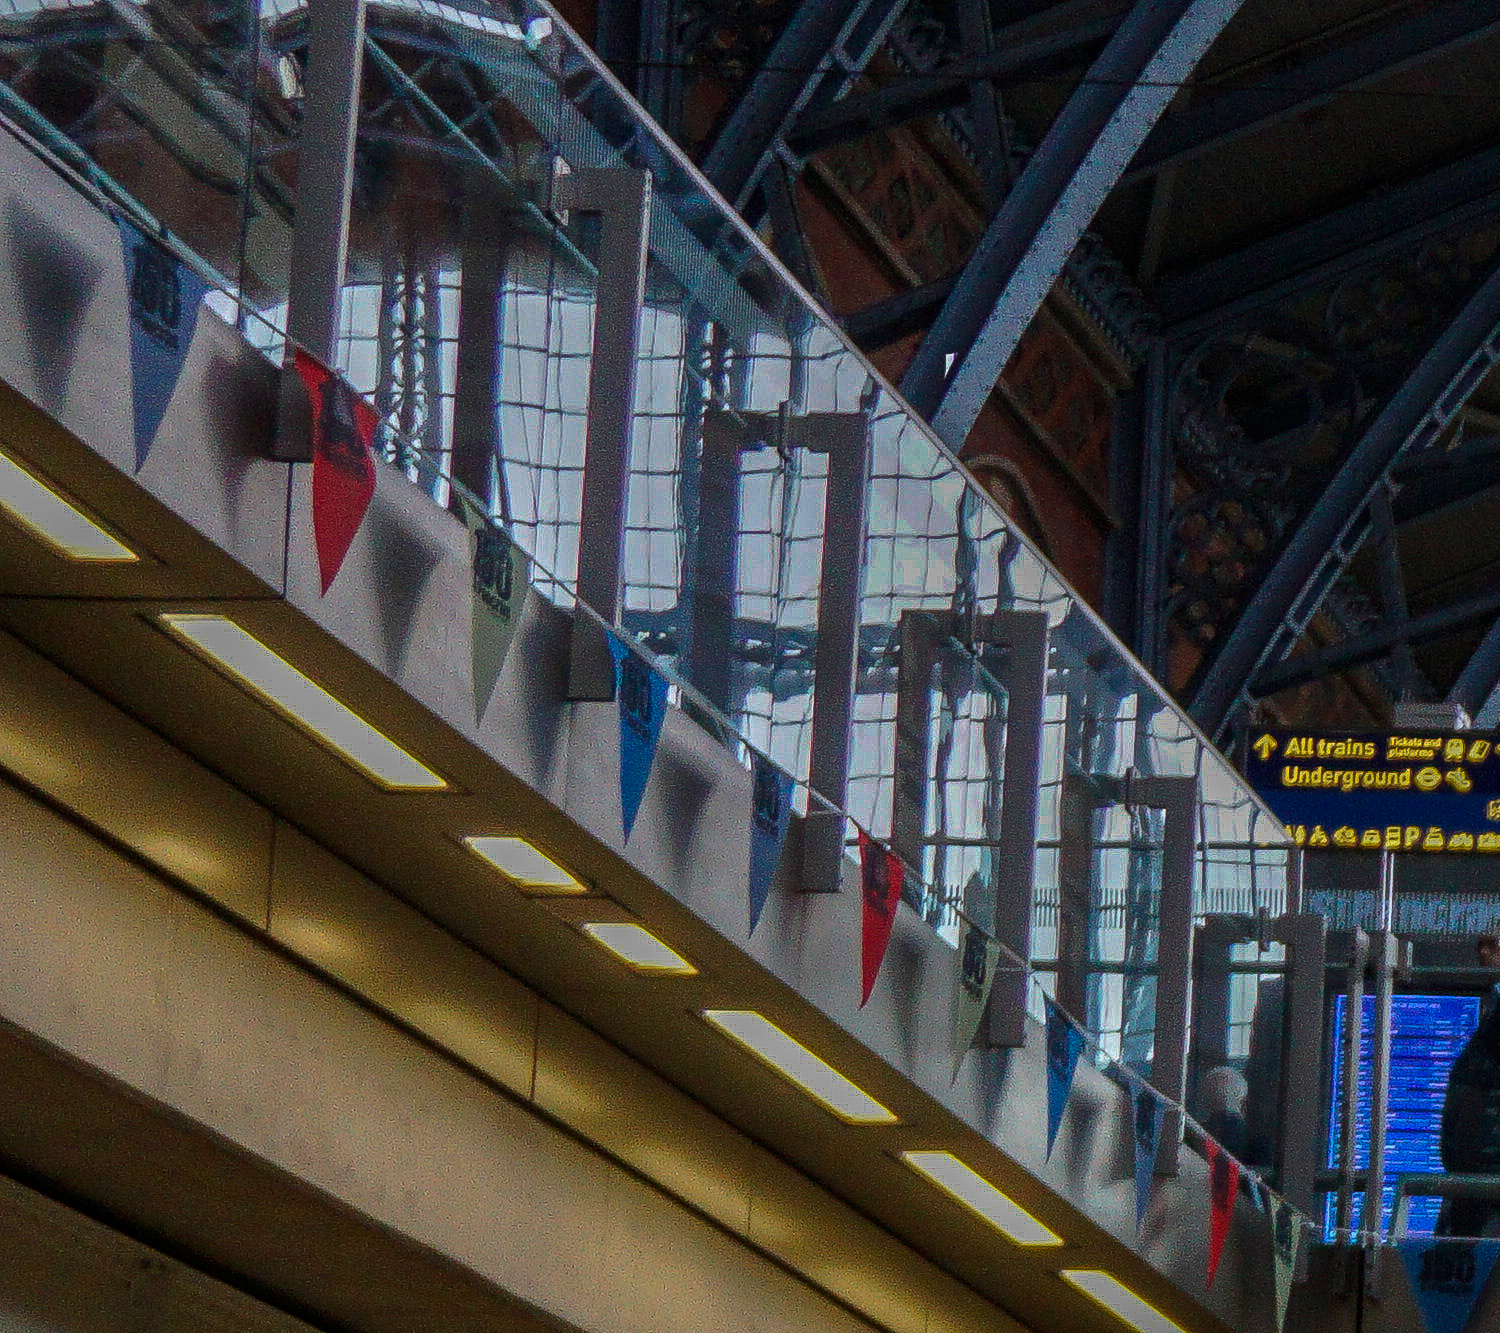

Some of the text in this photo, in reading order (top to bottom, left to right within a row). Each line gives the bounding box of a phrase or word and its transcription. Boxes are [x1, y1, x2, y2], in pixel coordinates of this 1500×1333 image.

[1286, 738, 1375, 757] All trains
[1283, 766, 1411, 791] Underground
